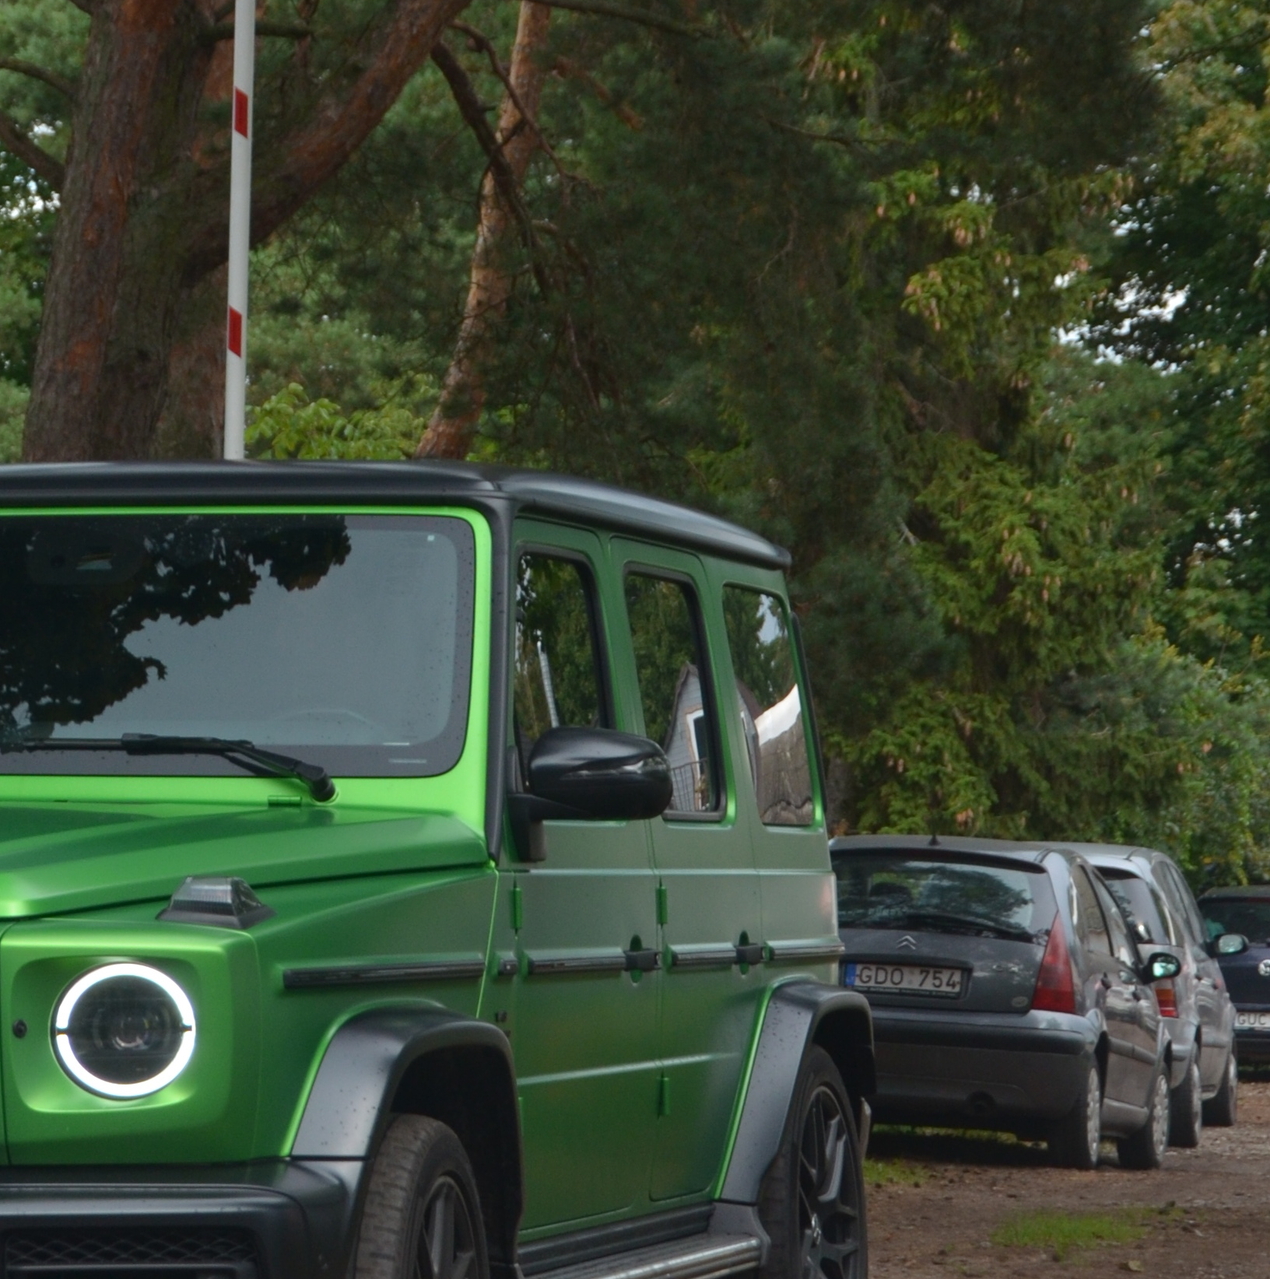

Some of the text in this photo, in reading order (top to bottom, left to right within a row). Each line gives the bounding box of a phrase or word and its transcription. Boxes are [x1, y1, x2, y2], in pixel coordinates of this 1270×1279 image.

[858, 966, 958, 990] GDO 754
[1237, 1013, 1266, 1026] GUC
